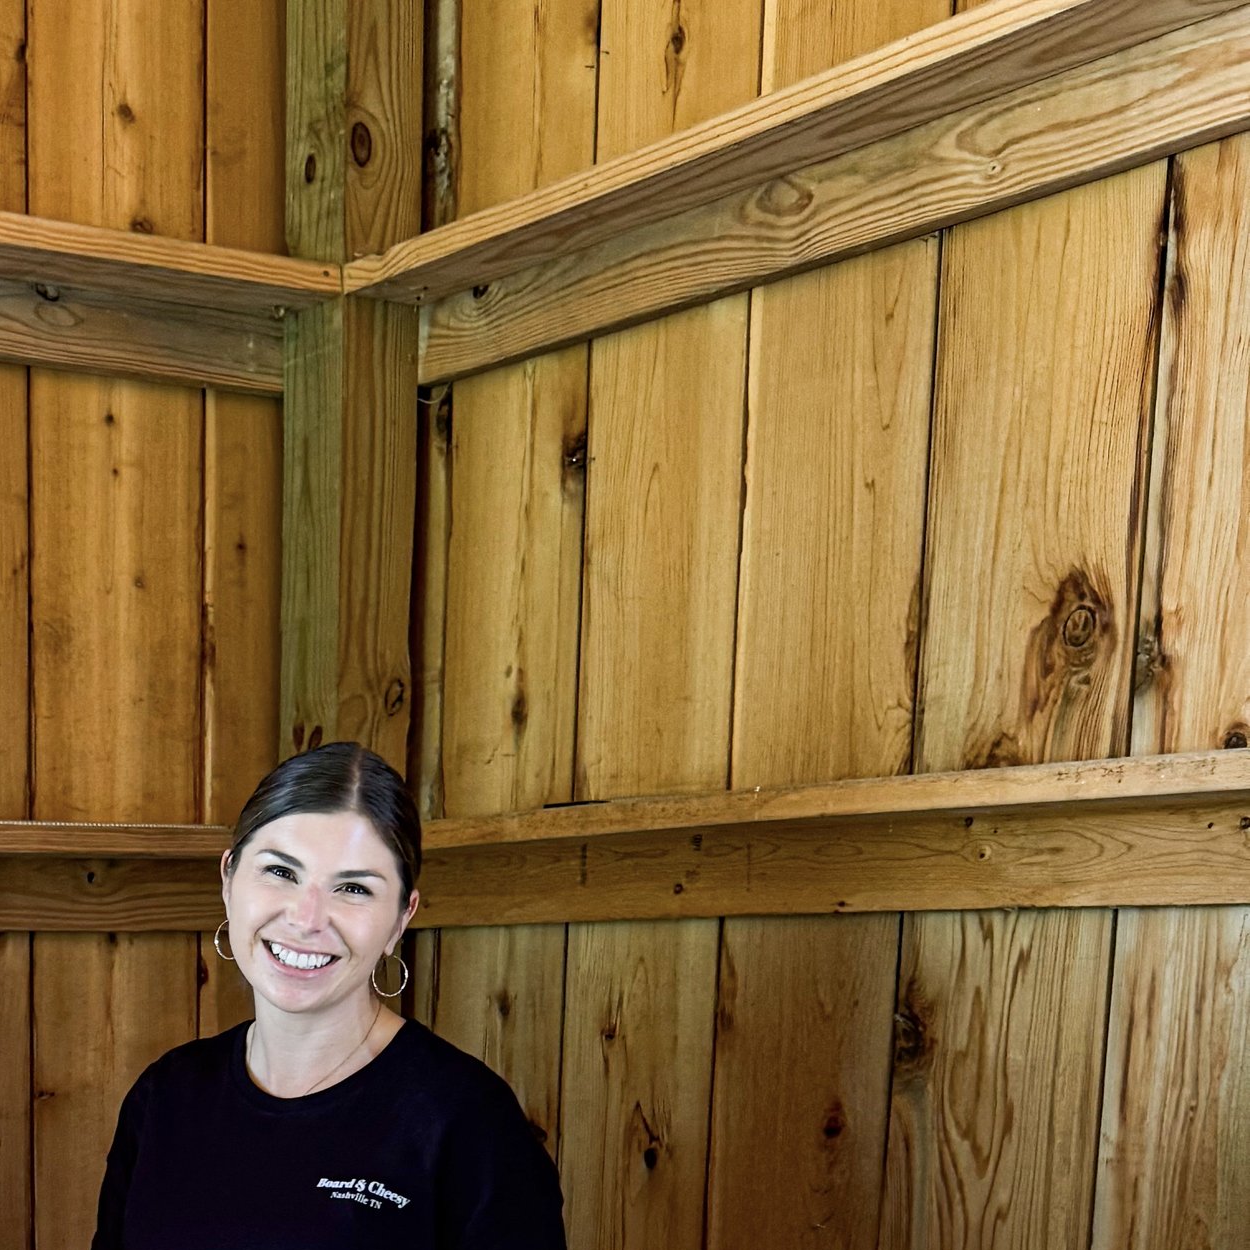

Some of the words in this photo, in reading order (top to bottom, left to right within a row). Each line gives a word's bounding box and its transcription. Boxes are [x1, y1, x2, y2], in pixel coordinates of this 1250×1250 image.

[316, 1178, 356, 1188] Board
[355, 1179, 367, 1192] &
[368, 1181, 410, 1209] Cheesy
[330, 1191, 368, 1205] Nashville
[370, 1199, 382, 1209] TN
